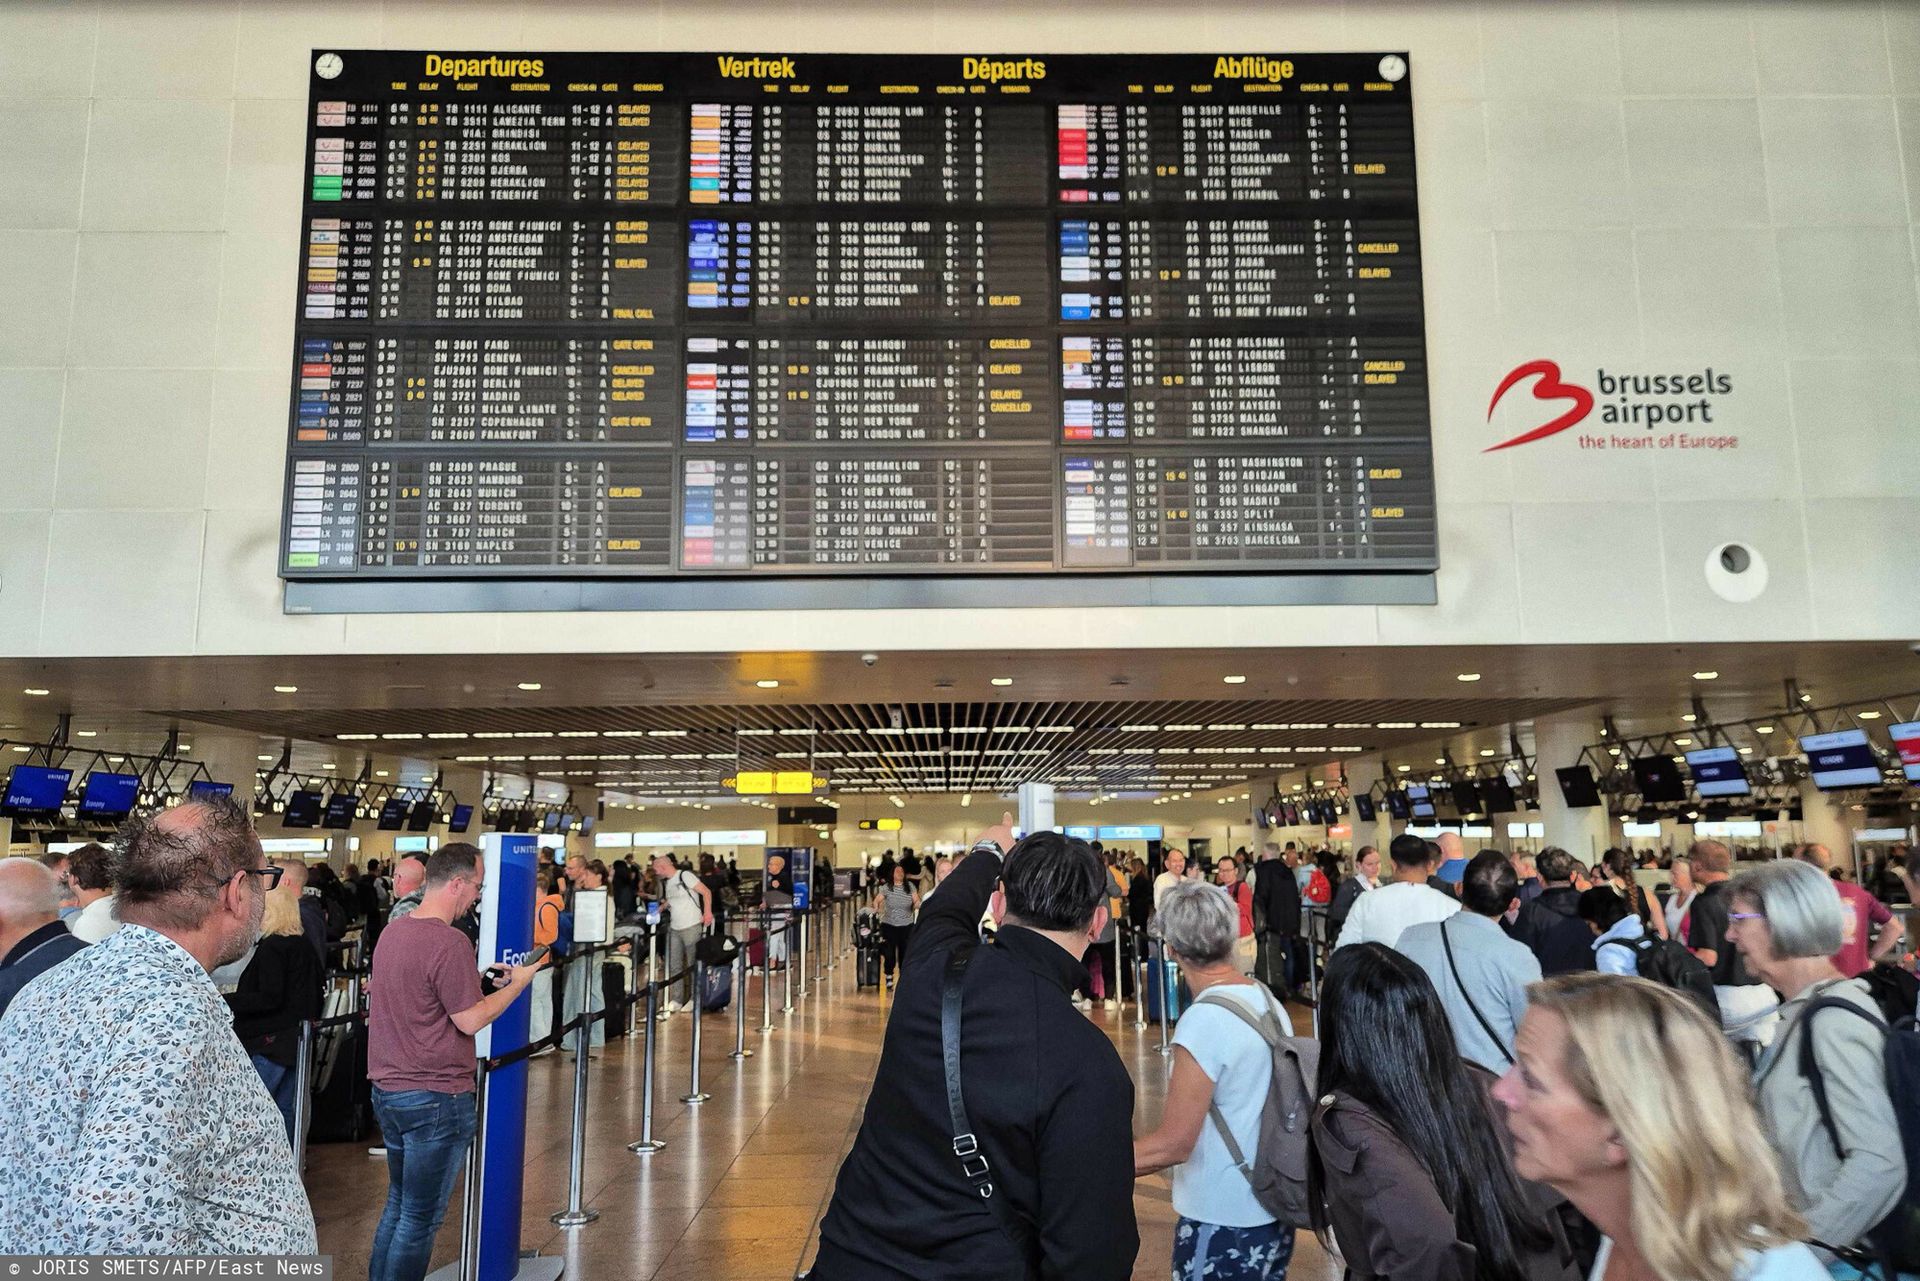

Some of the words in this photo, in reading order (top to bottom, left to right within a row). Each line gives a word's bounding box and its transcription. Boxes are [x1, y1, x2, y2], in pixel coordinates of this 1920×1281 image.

[425, 55, 545, 80] Departures
[717, 55, 797, 79] Vertrek
[962, 57, 1047, 83] Départs
[1213, 56, 1295, 82] Abflüge
[494, 105, 541, 114] ALICANTE
[864, 107, 900, 116] LONDON
[1228, 106, 1281, 115] MARSEILLE
[864, 119, 900, 128] MALAGA
[1229, 118, 1252, 127] NICE
[864, 131, 900, 140] VIENNA
[1230, 130, 1271, 139] TANGIER
[492, 141, 546, 150] HERAKLION
[864, 143, 900, 152] DUBLIN
[864, 155, 924, 164] MANCHESTER
[1230, 154, 1290, 163] CASABLANCA
[864, 167, 911, 176] MONTREAL
[1231, 166, 1272, 175] CONAKRY
[491, 178, 545, 187] HERAKLION
[1231, 178, 1261, 187] DAKAR
[491, 190, 538, 199] TENERIFE
[864, 192, 900, 201] MALAGA
[1233, 190, 1278, 200] ISTANBUL
[489, 221, 513, 230] ROME
[520, 222, 561, 230] FIUMICI
[864, 222, 906, 232] CHICAGO
[1233, 221, 1269, 230] ATHENS
[488, 234, 543, 243] AMSTERDAM
[864, 235, 900, 244] WARSAW
[1233, 233, 1269, 242] NEWARK
[488, 246, 543, 255] BARCELONA
[864, 247, 917, 256] BUCHAREST
[1234, 245, 1304, 254] THESSALONIKI
[1358, 244, 1399, 253] CANCELLED
[488, 259, 536, 268] FLORENCE
[864, 260, 924, 268] COPENHAGEN
[1235, 257, 1265, 267] ZADAR
[487, 271, 510, 280] ROME
[518, 271, 559, 280] FIUMICI
[864, 272, 901, 281] DUBLIN
[1235, 270, 1276, 279] ENTEBBE
[864, 284, 918, 293] BARCELONA
[1235, 282, 1270, 292] KIGALI
[486, 296, 523, 305] BILBAO
[864, 297, 900, 305] CHANIA
[1235, 295, 1271, 304] BEIRUT
[486, 309, 522, 318] LISBON
[1236, 307, 1259, 316] ROME
[1266, 307, 1307, 316] FIUMICI
[485, 340, 509, 349] FARO
[864, 340, 906, 349] NAIROBI
[990, 339, 1031, 349] CANCELLED
[1237, 338, 1284, 347] HELSINKI
[484, 353, 521, 362] GENEVA
[864, 353, 900, 362] KIGALI
[1238, 350, 1285, 360] FLORENCE
[483, 366, 508, 375] ROME
[515, 366, 557, 375] FIUMICI
[864, 366, 918, 375] FRANKFURT
[990, 365, 1022, 374] DELAYED
[1239, 363, 1275, 372] LISBON
[483, 379, 520, 388] BERLIN
[864, 379, 895, 387] MILAN
[901, 378, 936, 387] LINATE
[1597, 367, 1733, 395] brussels
[483, 392, 520, 400] MADRID
[864, 391, 895, 400] PORTO
[990, 390, 1022, 399] DELAYED
[1239, 388, 1275, 397] DOUALA
[482, 405, 513, 413] MILAN
[520, 405, 556, 413] LINATE
[864, 404, 919, 413] AMSTERDAM
[991, 403, 1031, 412] CANCELLED
[1240, 401, 1281, 410] KAYSERI
[1601, 397, 1713, 429] airport
[481, 417, 544, 426] COPENHAGEN
[864, 417, 883, 426] NEW
[889, 417, 912, 425] YORK
[1240, 414, 1276, 423] MALAGA
[481, 430, 537, 439] FRANKFURT
[864, 430, 901, 438] LONDON
[1241, 426, 1288, 435] SHANGHAI
[1579, 434, 1606, 449] the
[1611, 434, 1654, 449] heart
[1658, 434, 1675, 449] of
[1678, 434, 1739, 451] Europe
[480, 462, 516, 471] PRAGUE
[864, 462, 919, 470] HERAKLION
[1242, 458, 1302, 467] WASHINGTON
[479, 475, 523, 484] HAMBURG
[864, 474, 901, 483] MADRID
[1243, 471, 1285, 479] ABIDJAN
[478, 488, 516, 497] MUNICH
[864, 487, 883, 496] NEW
[889, 487, 913, 496] YORK
[1244, 483, 1297, 493] SINGAPORE
[864, 500, 926, 509] WASHINGTON
[1243, 496, 1280, 505] MADRID
[479, 501, 522, 510] TORONTO
[864, 513, 895, 522] MILAN
[901, 513, 937, 522] LINATE
[1244, 509, 1273, 518] SPLIT
[479, 514, 527, 523] TOULOUSE
[1245, 523, 1293, 531] KINSHASA
[477, 528, 514, 537] ZURICH
[864, 539, 900, 548] VENICE
[1245, 535, 1300, 544] BARCELONA
[476, 541, 514, 550] NAPLES
[475, 554, 500, 563] RIGA
[865, 552, 889, 561] LYON
